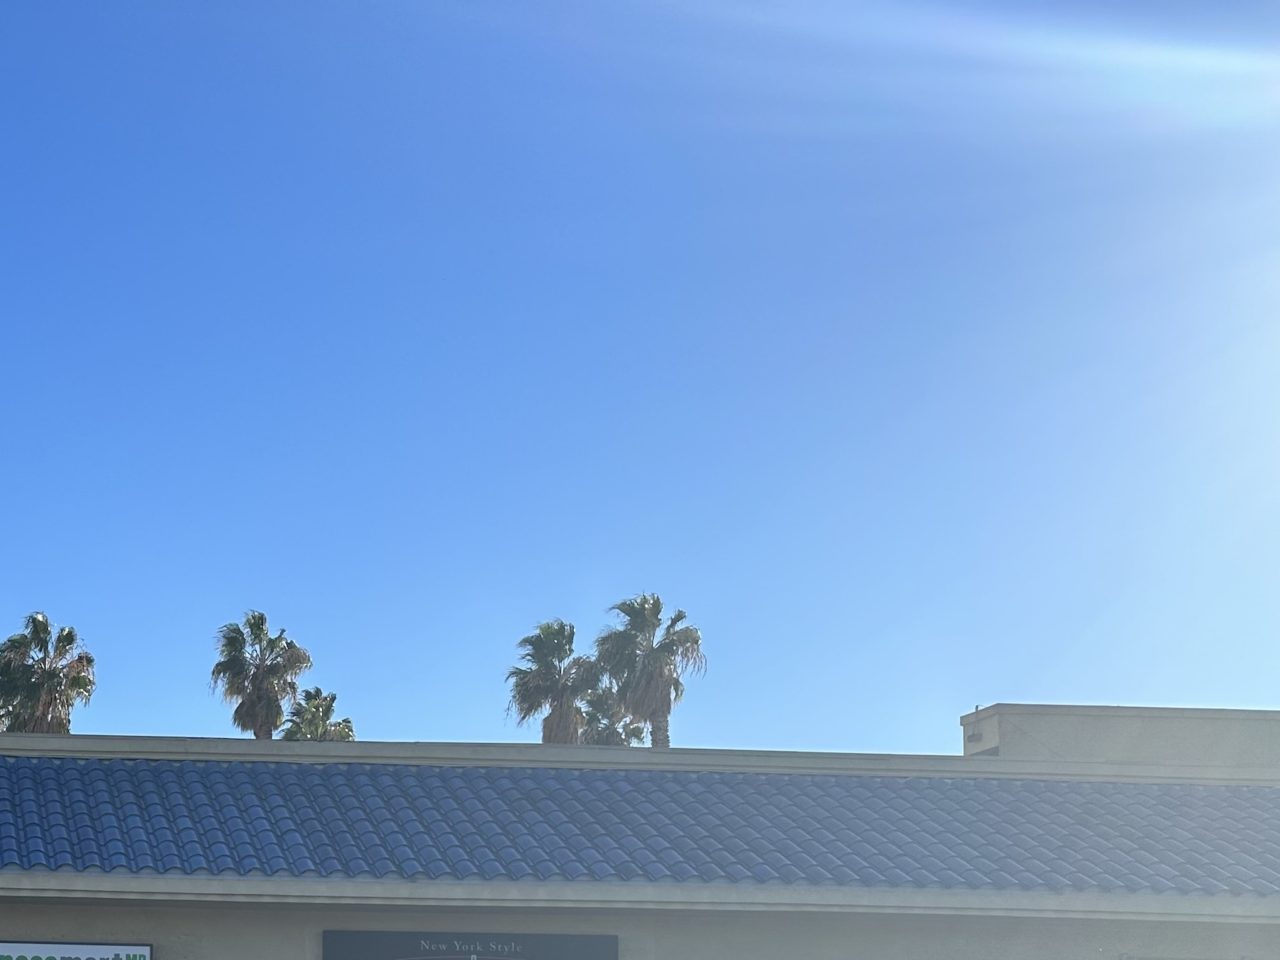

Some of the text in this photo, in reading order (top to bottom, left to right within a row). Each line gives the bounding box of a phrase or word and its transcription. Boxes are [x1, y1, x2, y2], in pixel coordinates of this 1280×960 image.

[420, 940, 523, 954] New York Style
